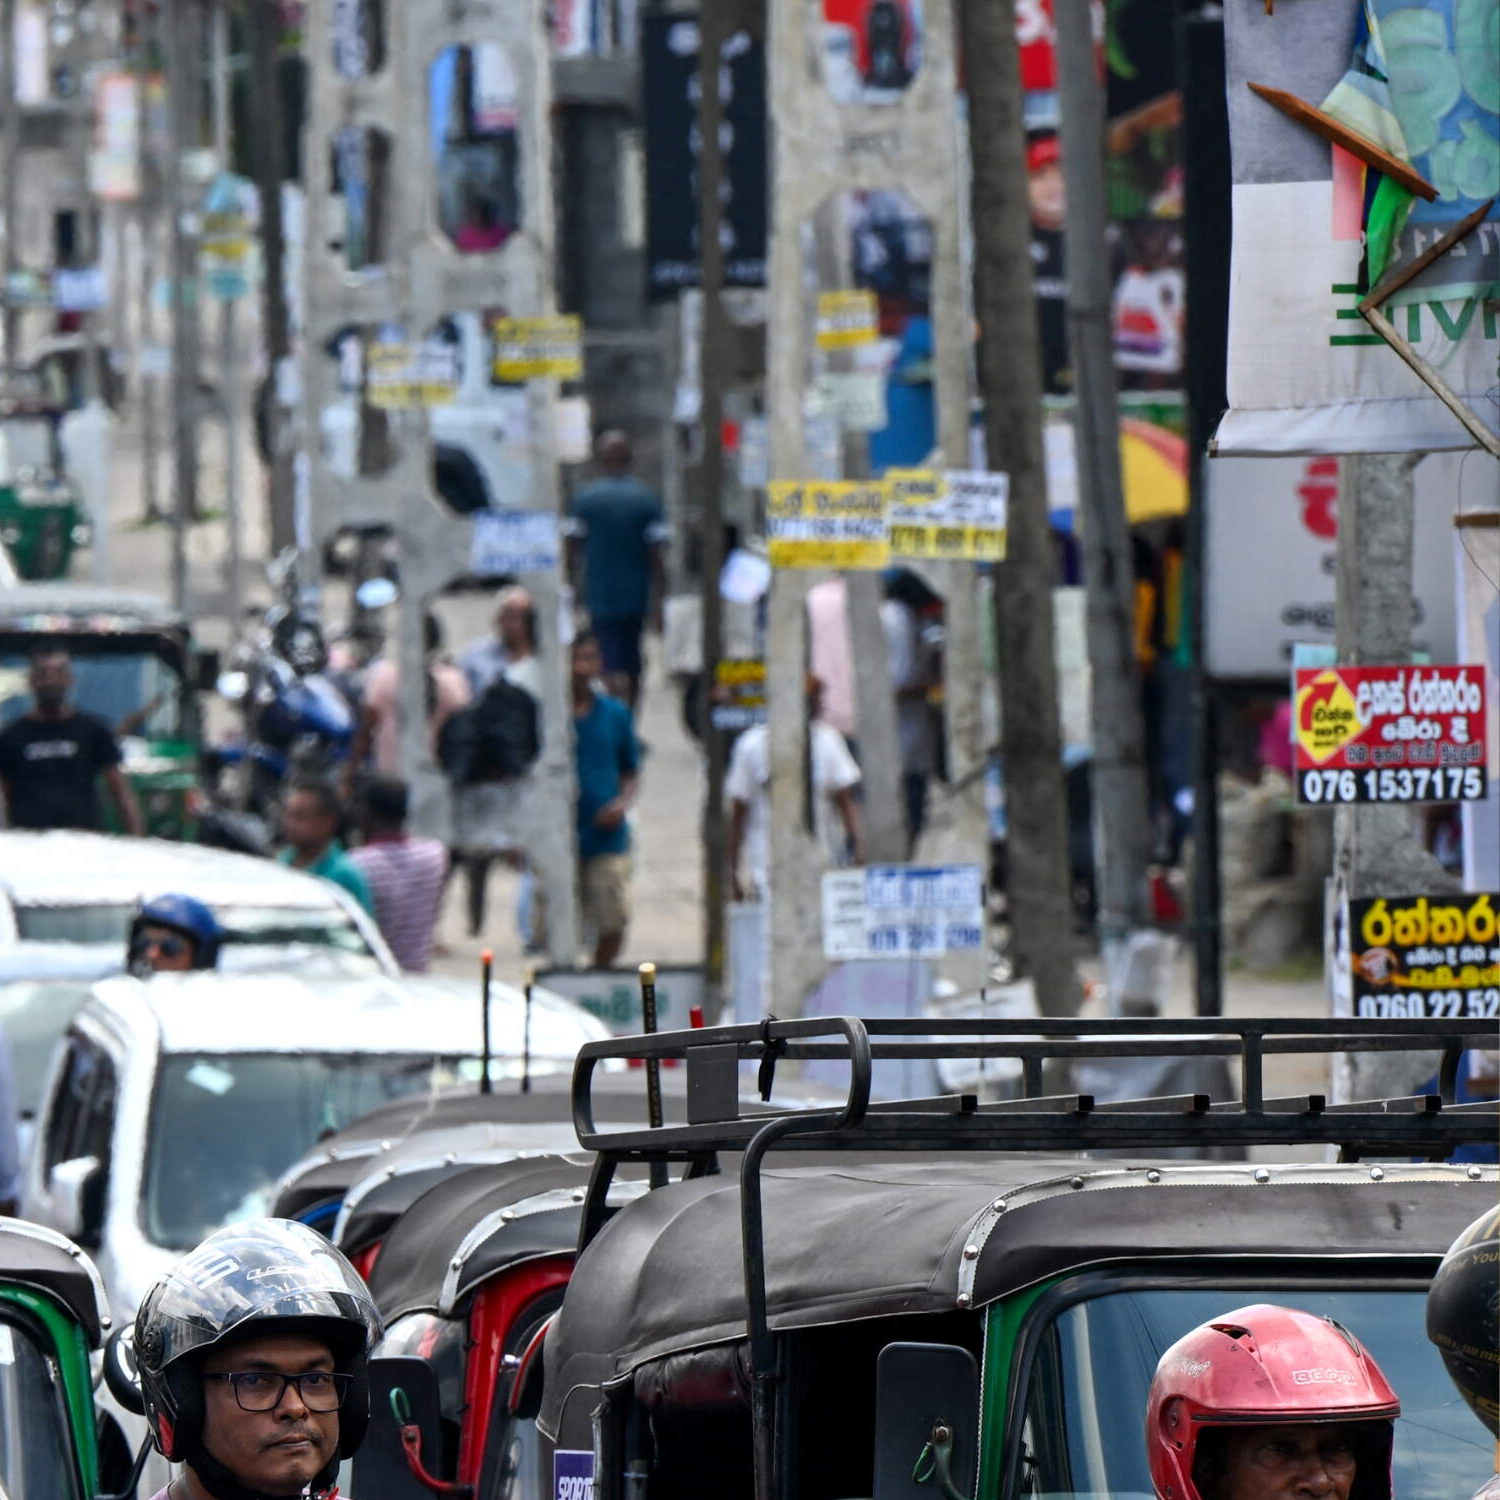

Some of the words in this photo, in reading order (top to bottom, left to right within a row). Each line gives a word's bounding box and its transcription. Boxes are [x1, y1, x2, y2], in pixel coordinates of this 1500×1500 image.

[1304, 770, 1357, 801] 076
[1364, 767, 1482, 800] 1537175
[1361, 894, 1500, 947] රත්තර
